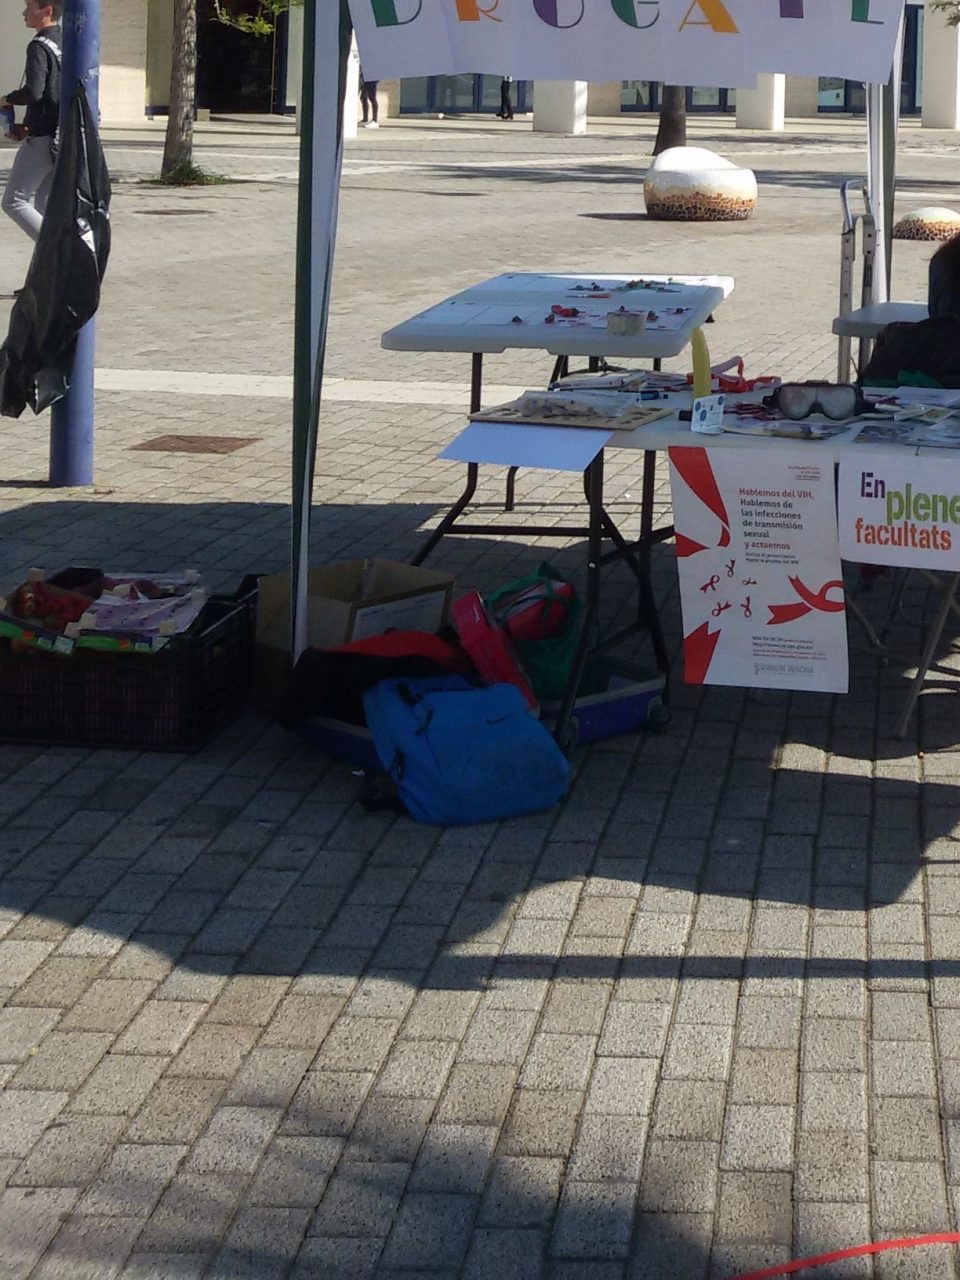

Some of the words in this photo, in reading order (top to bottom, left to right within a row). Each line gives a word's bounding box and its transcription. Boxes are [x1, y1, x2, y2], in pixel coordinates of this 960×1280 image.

[860, 471, 886, 499] En
[739, 488, 780, 497] Hablemos
[782, 489, 796, 498] del
[740, 498, 781, 507] Hablemos
[755, 510, 801, 519] infecciones
[742, 519, 753, 527] de
[755, 521, 802, 530] transmisión
[855, 516, 953, 551] facultats
[744, 541, 750, 550] y
[751, 542, 790, 550] actuemos
